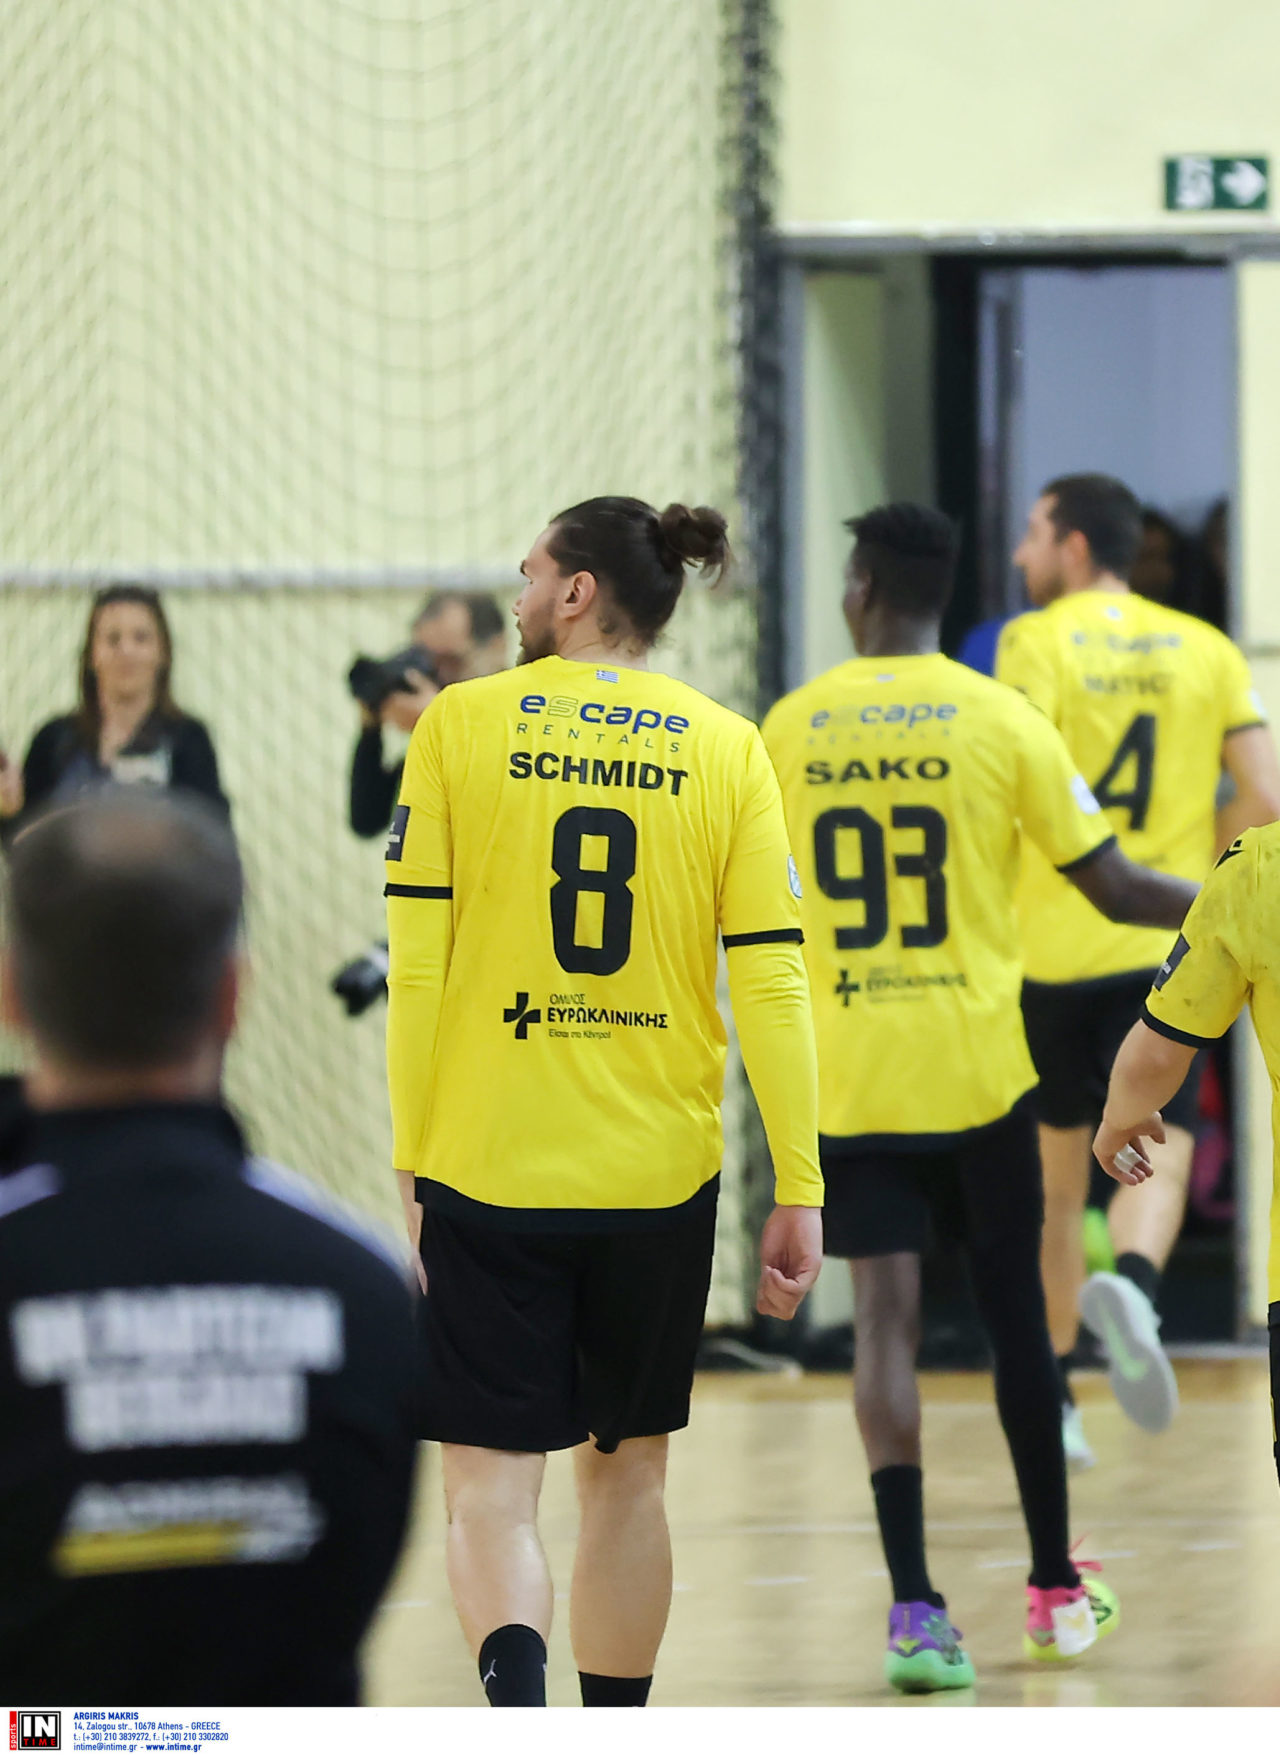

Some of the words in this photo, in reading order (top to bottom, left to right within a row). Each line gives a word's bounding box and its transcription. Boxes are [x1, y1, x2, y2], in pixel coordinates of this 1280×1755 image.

[520, 694, 690, 734] escape
[810, 703, 958, 729] ecape
[516, 722, 681, 753] RENTALS
[509, 751, 689, 796] SCHMIDT
[805, 755, 951, 785] SAKO
[1094, 712, 1157, 832] 4
[550, 806, 637, 976] 8
[812, 804, 949, 950] 93
[547, 1006, 669, 1029] ΕΥΡΩΚΛΙΝΙΚΗΣ
